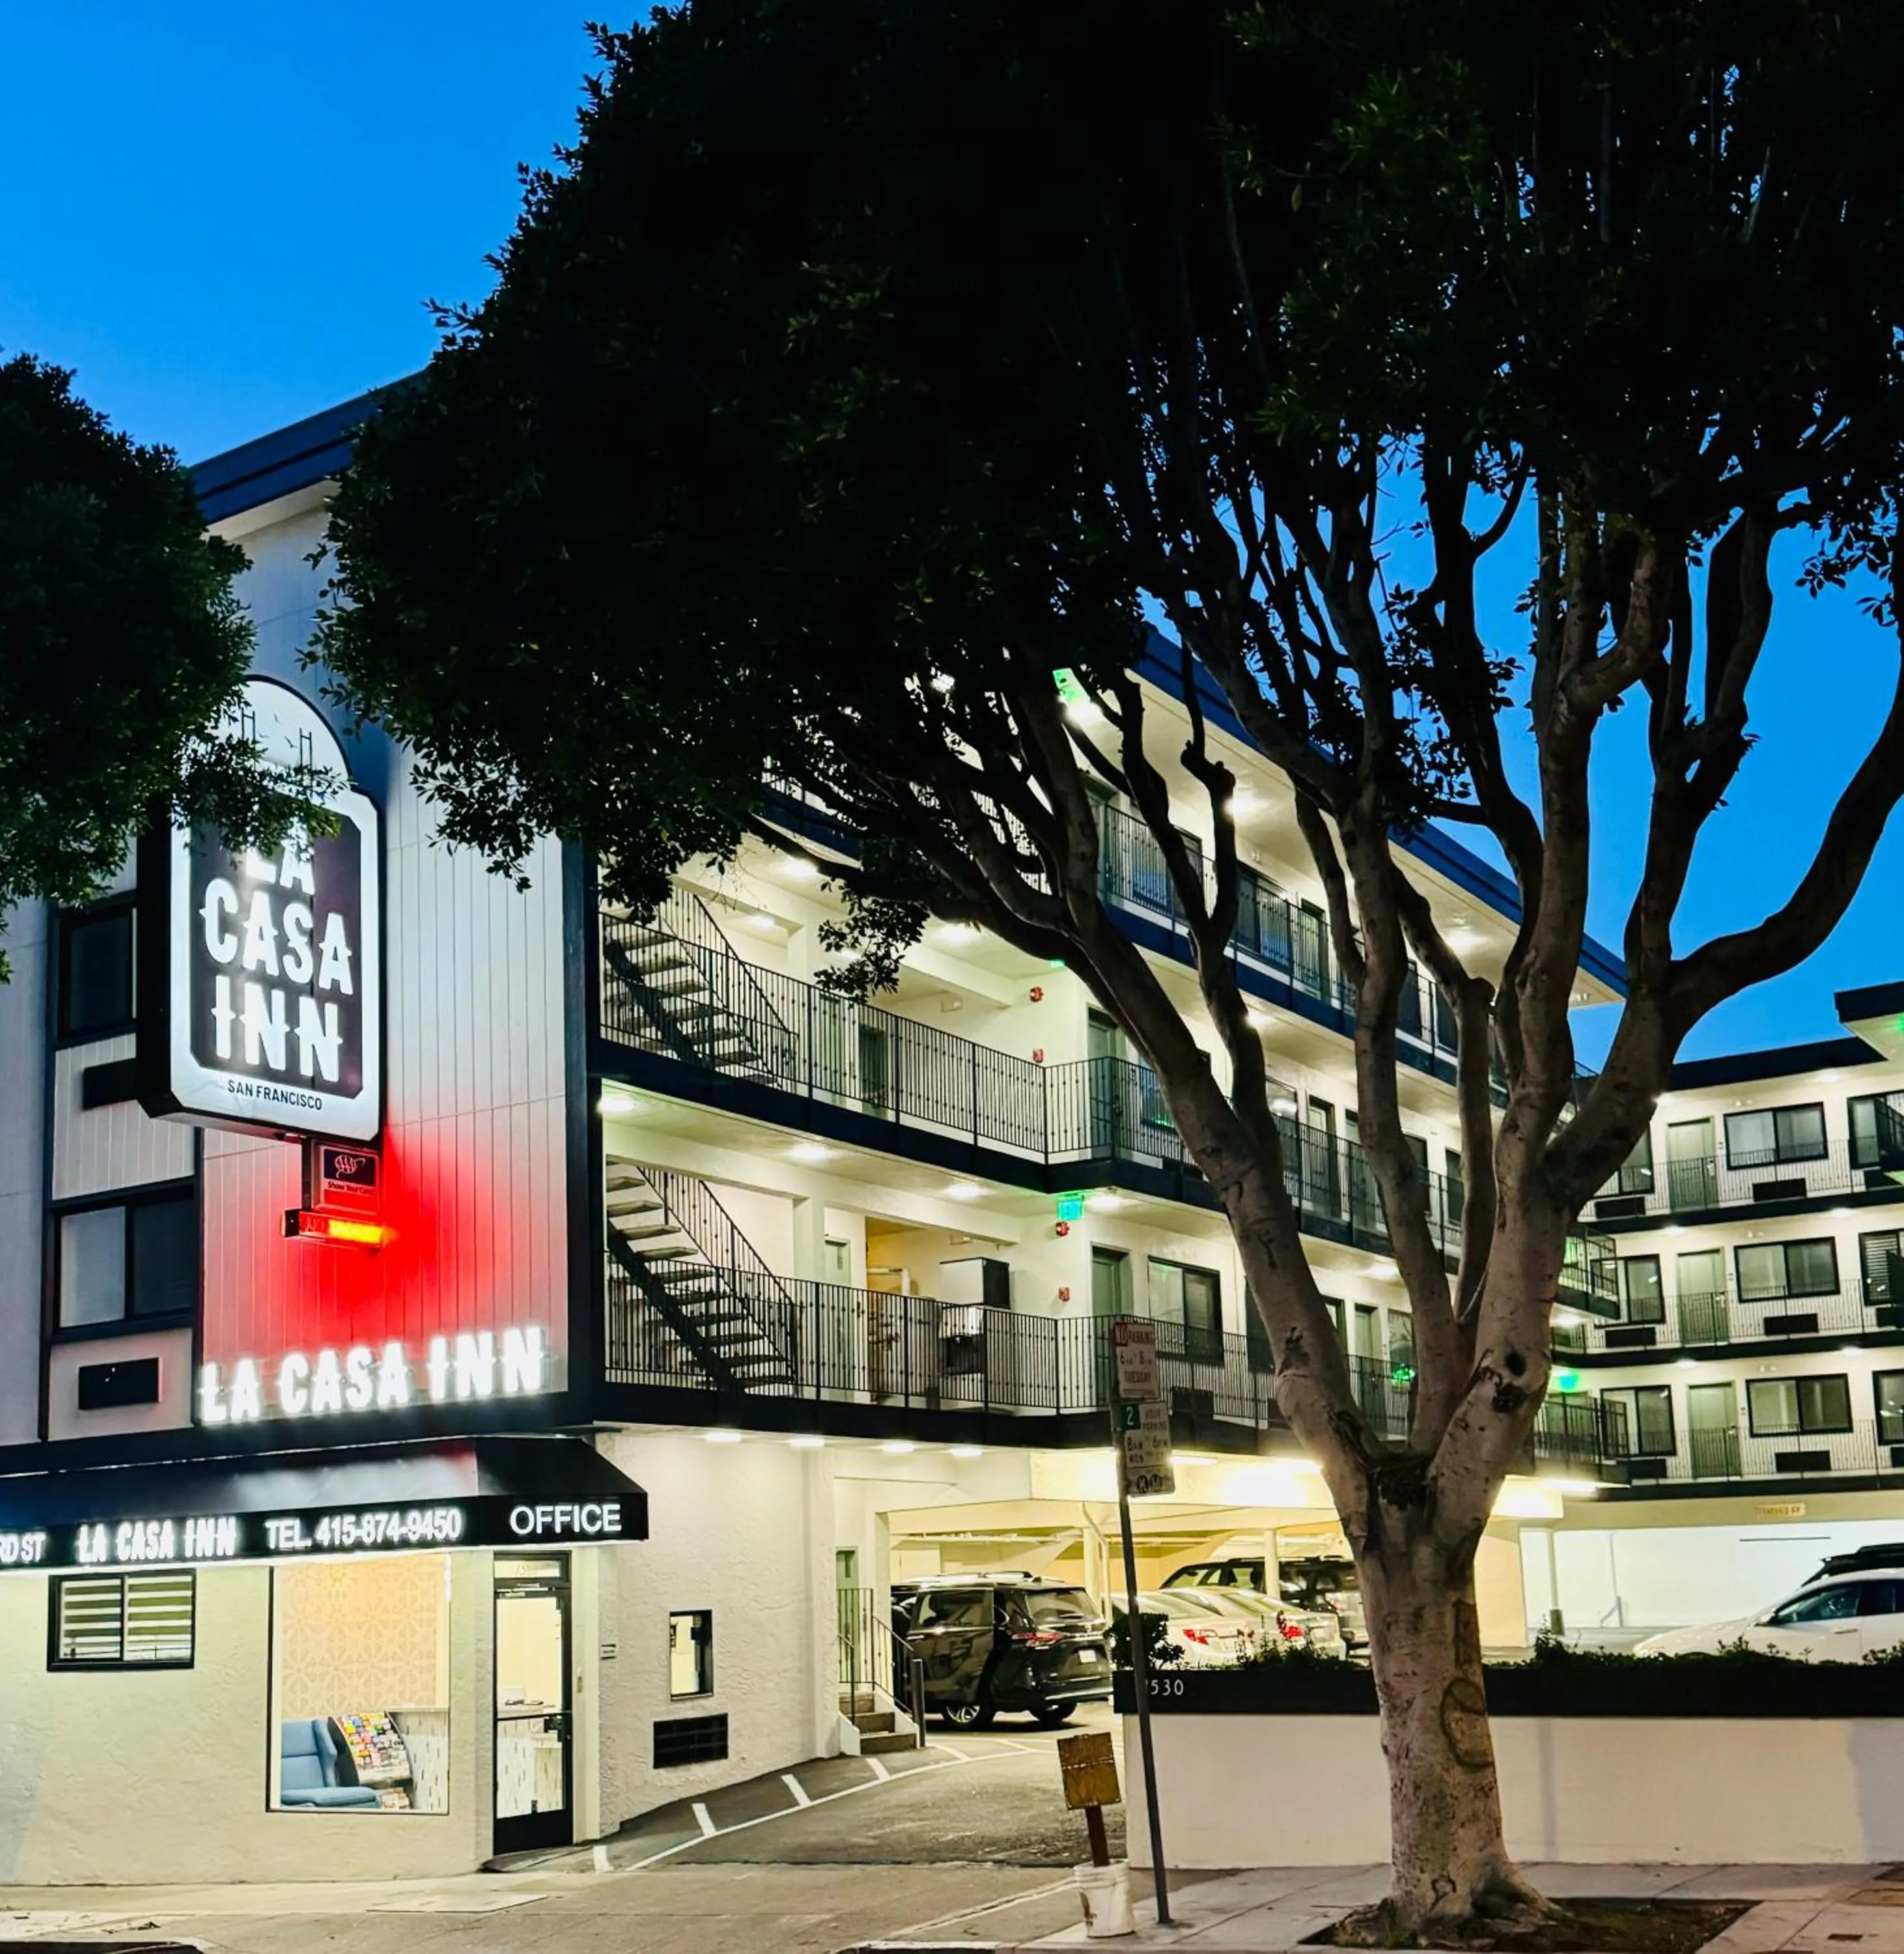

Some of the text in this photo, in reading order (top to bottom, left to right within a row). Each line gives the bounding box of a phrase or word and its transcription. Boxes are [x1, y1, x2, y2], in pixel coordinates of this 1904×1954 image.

[199, 878, 354, 995] CASA
[211, 975, 343, 1083] INN
[227, 1079, 322, 1110] SAN FRANCISCO
[199, 1326, 544, 1421] LA CASA INN
[1127, 1406, 1134, 1426] 2
[266, 1508, 462, 1550] TEL. 415-874-9450
[510, 1504, 621, 1535] OFFICE
[21, 1531, 46, 1563] ST
[76, 1516, 237, 1563] LA CASA INN
[1145, 1678, 1184, 1695] 530
